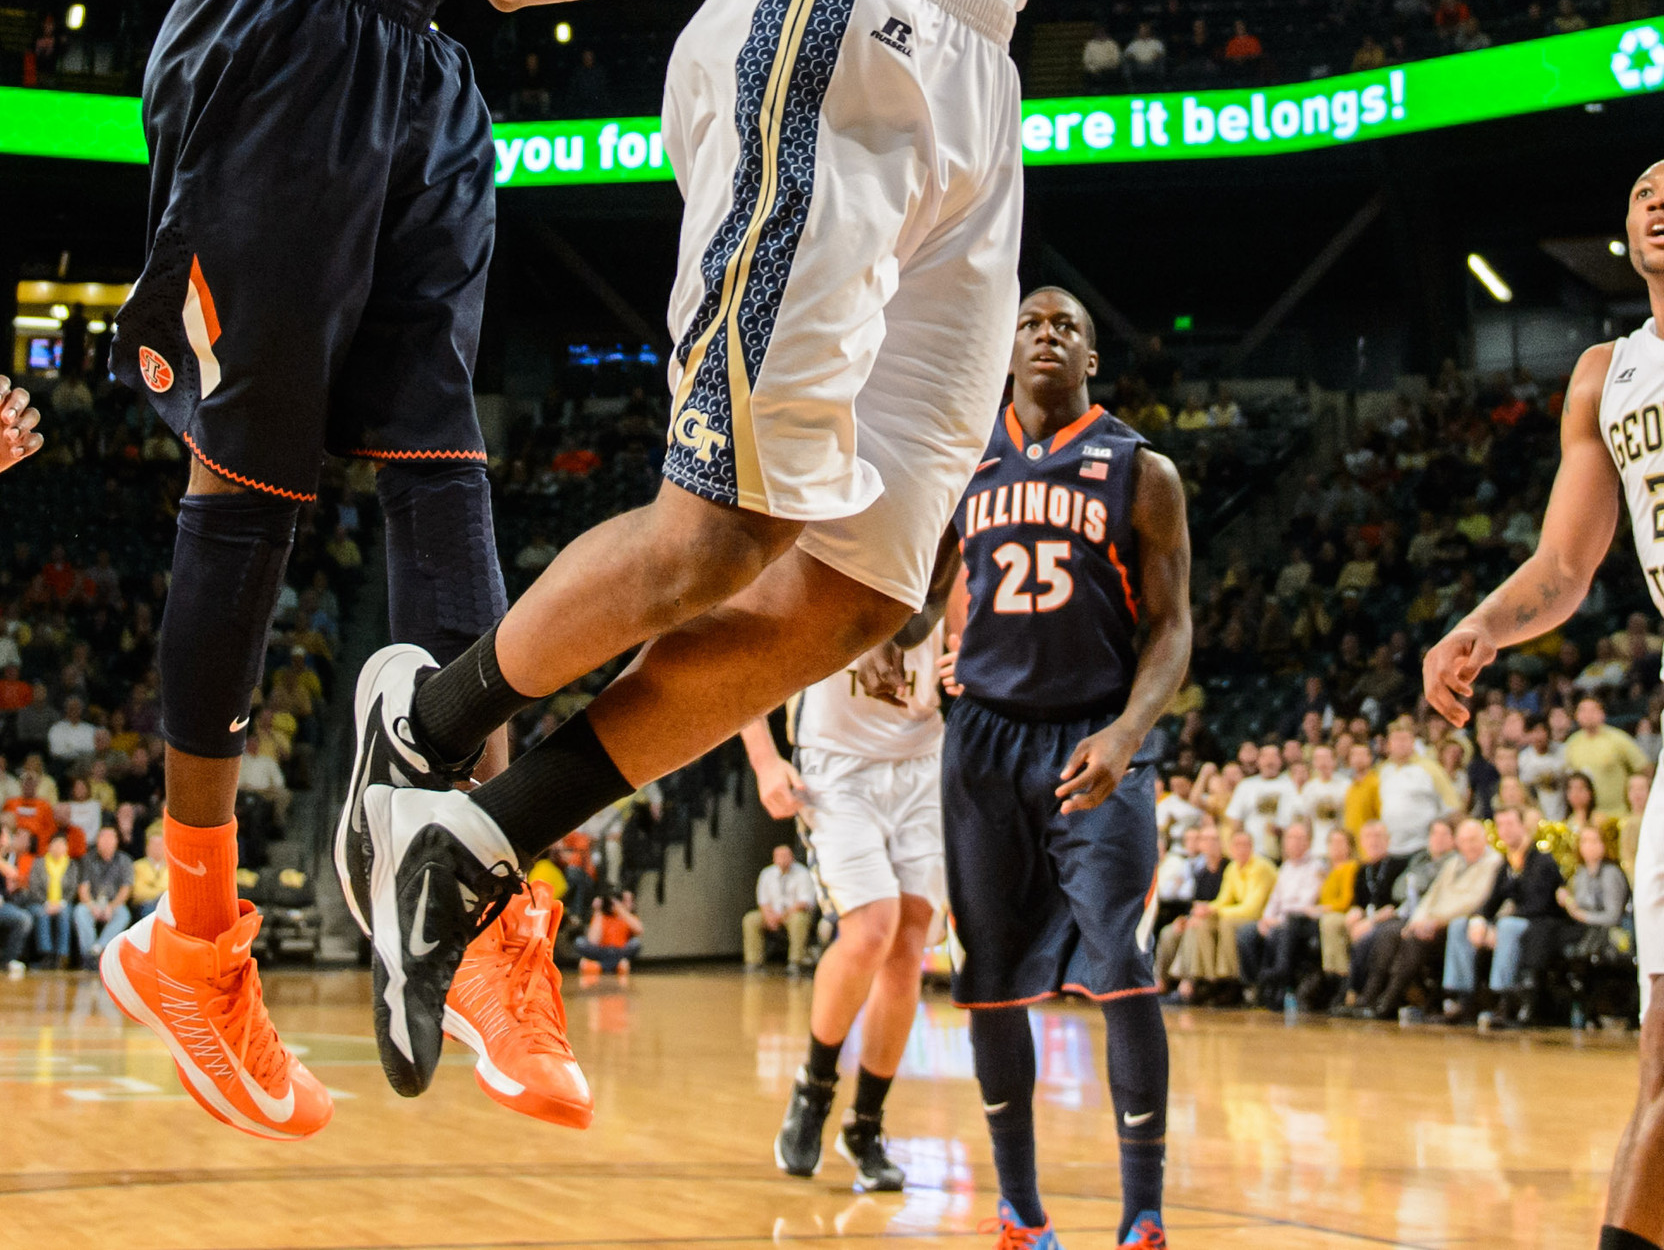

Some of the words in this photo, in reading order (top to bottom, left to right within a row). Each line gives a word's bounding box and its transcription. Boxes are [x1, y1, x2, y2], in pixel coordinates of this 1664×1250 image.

[495, 136, 583, 183] you
[1022, 112, 1114, 150] ere
[1131, 100, 1168, 147] it
[1183, 70, 1404, 140] belongs!
[966, 481, 1107, 543] ILLINOIS
[992, 541, 1073, 614] 25
